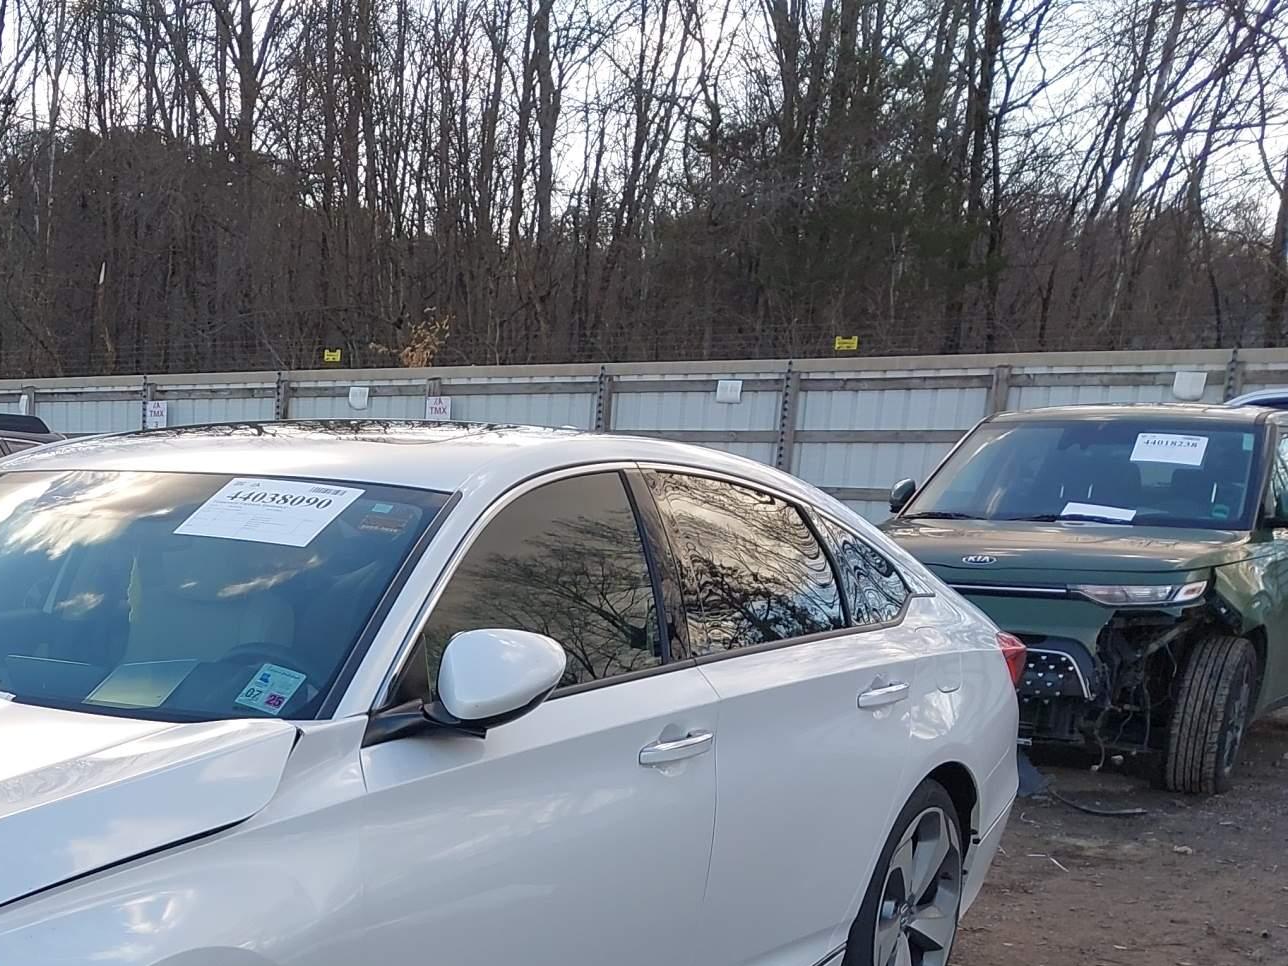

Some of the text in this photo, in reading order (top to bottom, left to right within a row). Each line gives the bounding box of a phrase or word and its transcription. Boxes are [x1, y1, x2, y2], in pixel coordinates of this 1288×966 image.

[429, 406, 448, 415] TMX
[227, 490, 333, 510] 44038090
[967, 555, 990, 563] KIA
[245, 687, 263, 698] 07
[265, 694, 285, 708] 25
